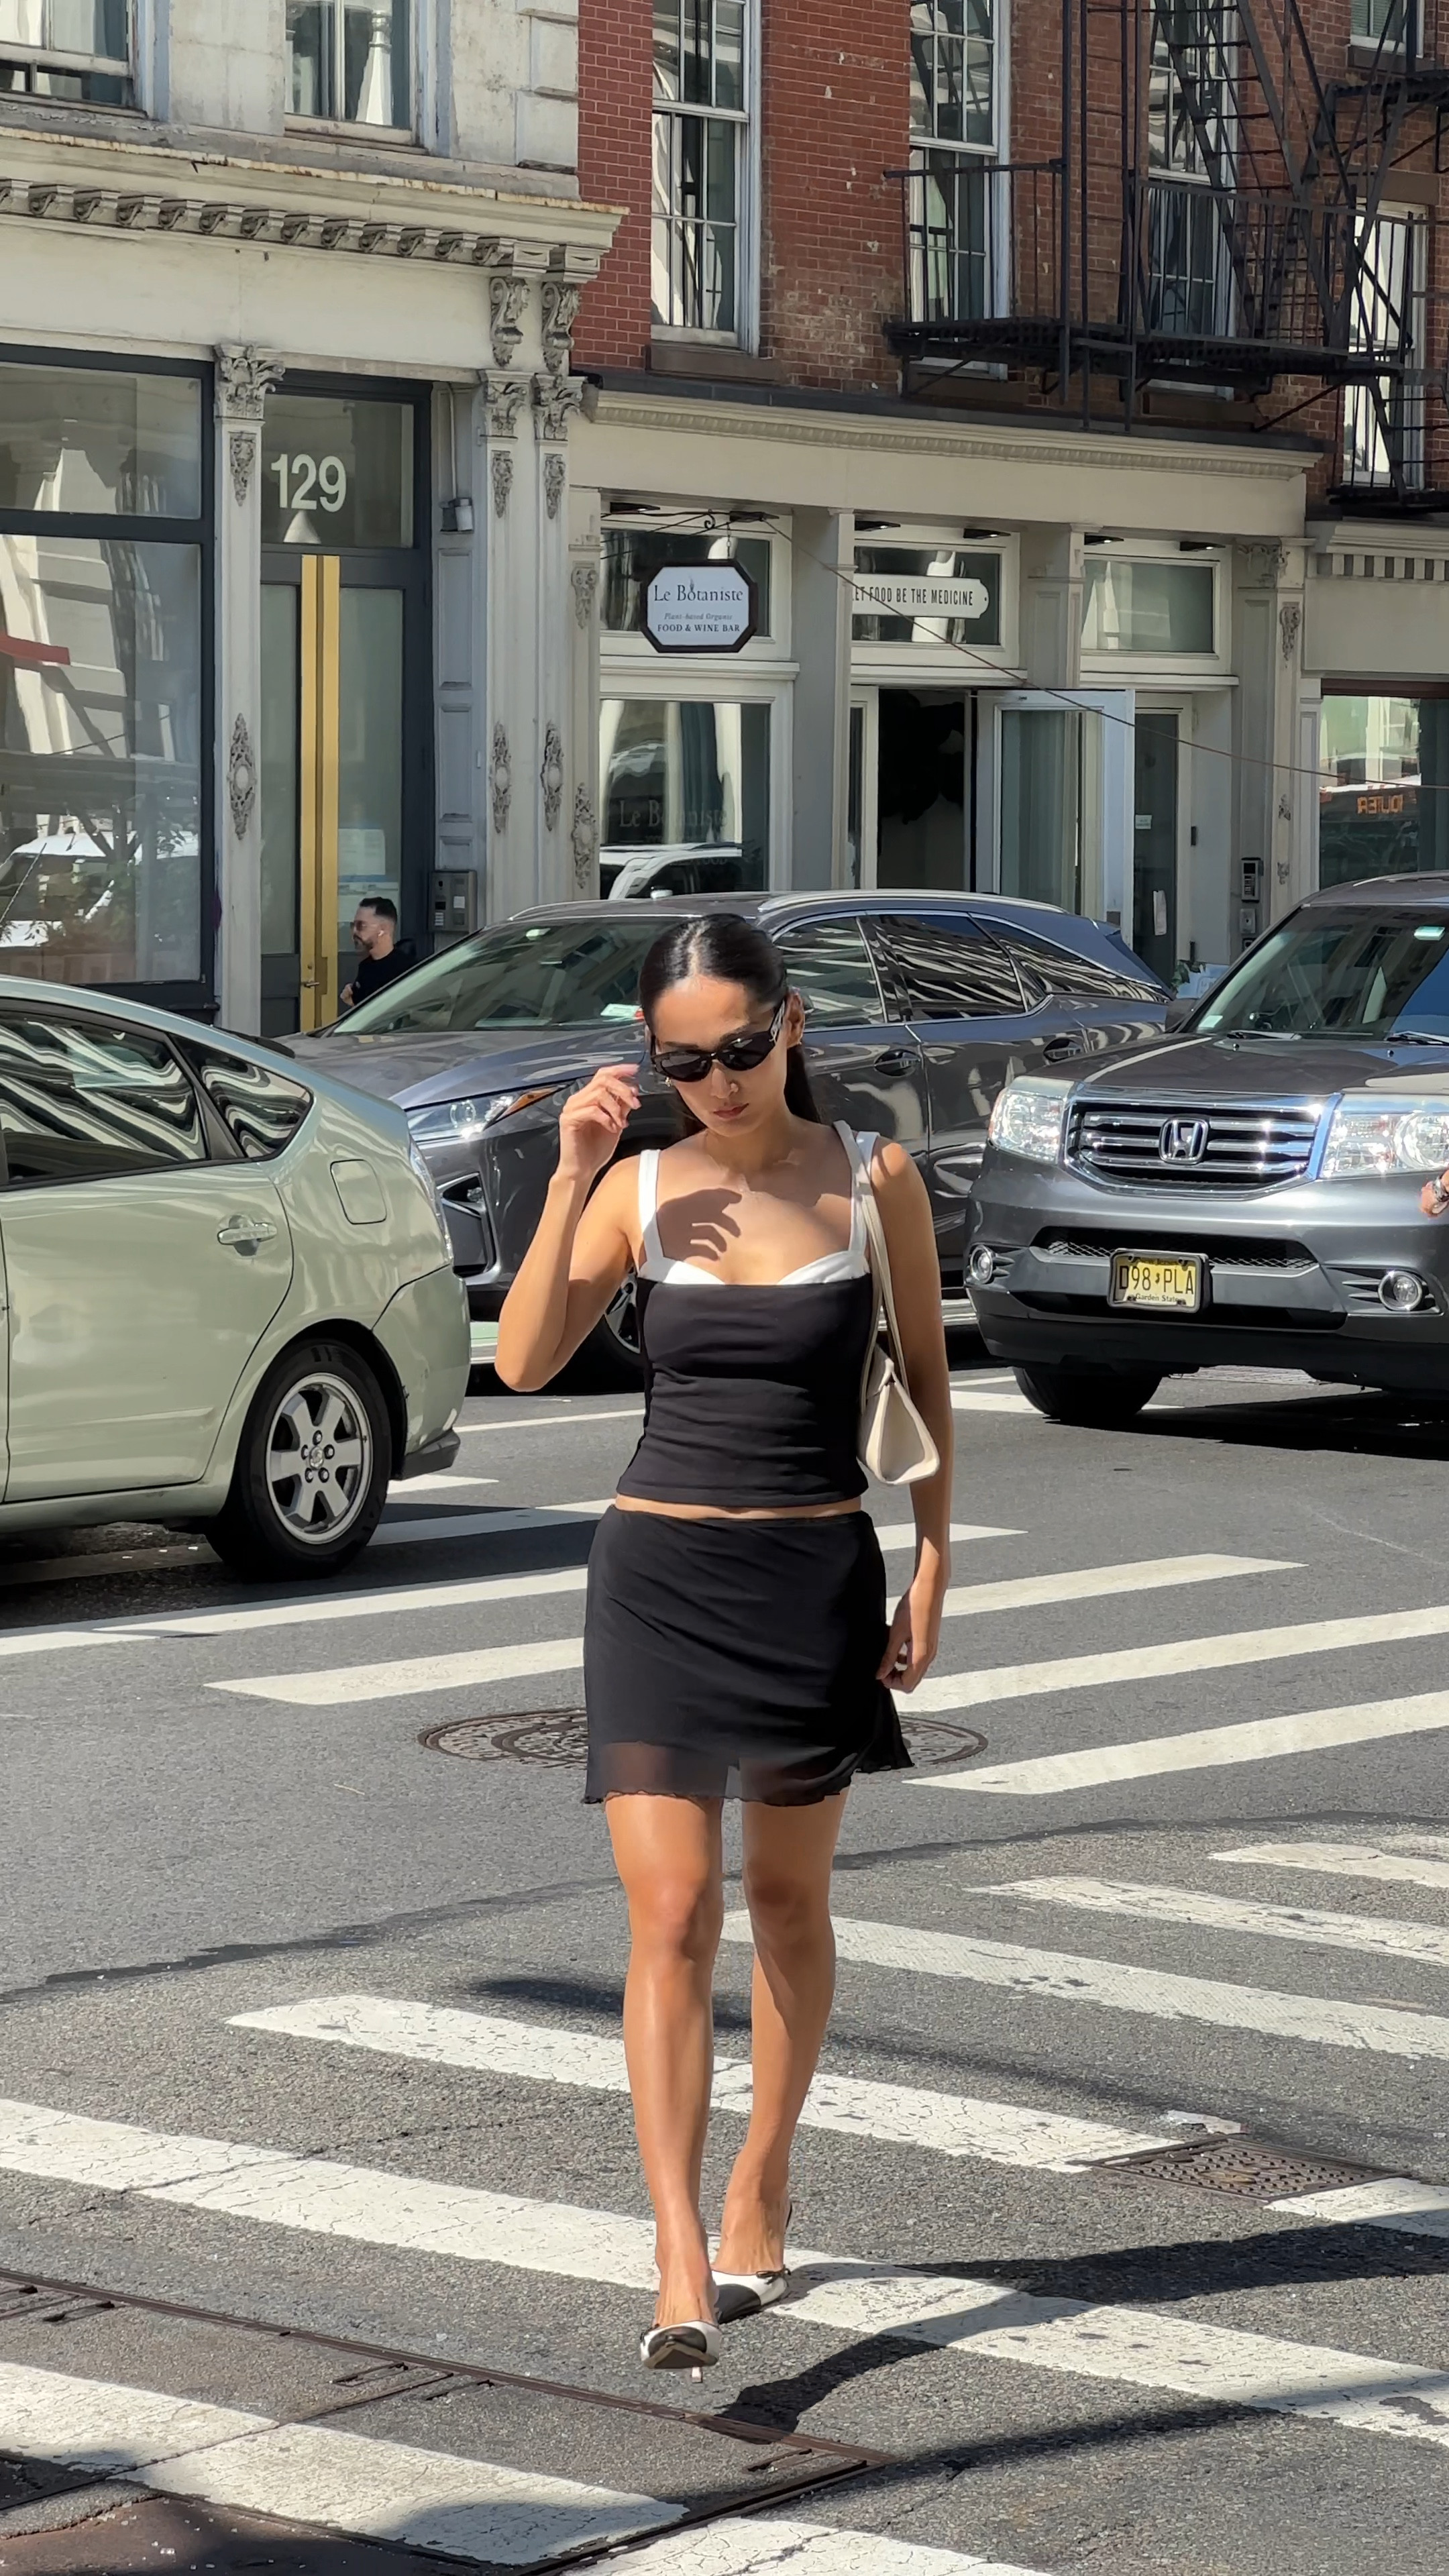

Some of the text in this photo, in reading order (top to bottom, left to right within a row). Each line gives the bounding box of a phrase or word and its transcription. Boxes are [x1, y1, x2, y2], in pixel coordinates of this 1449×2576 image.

[271, 453, 347, 513] 129
[655, 585, 671, 601] Le
[853, 586, 973, 606] ET FOOD BE THE MEDICINE
[657, 624, 740, 632] FOOD & WINE BAR
[619, 800, 641, 827] Le
[1119, 1265, 1194, 1295] D98 PLA
[1136, 1293, 1160, 1302] Garden
